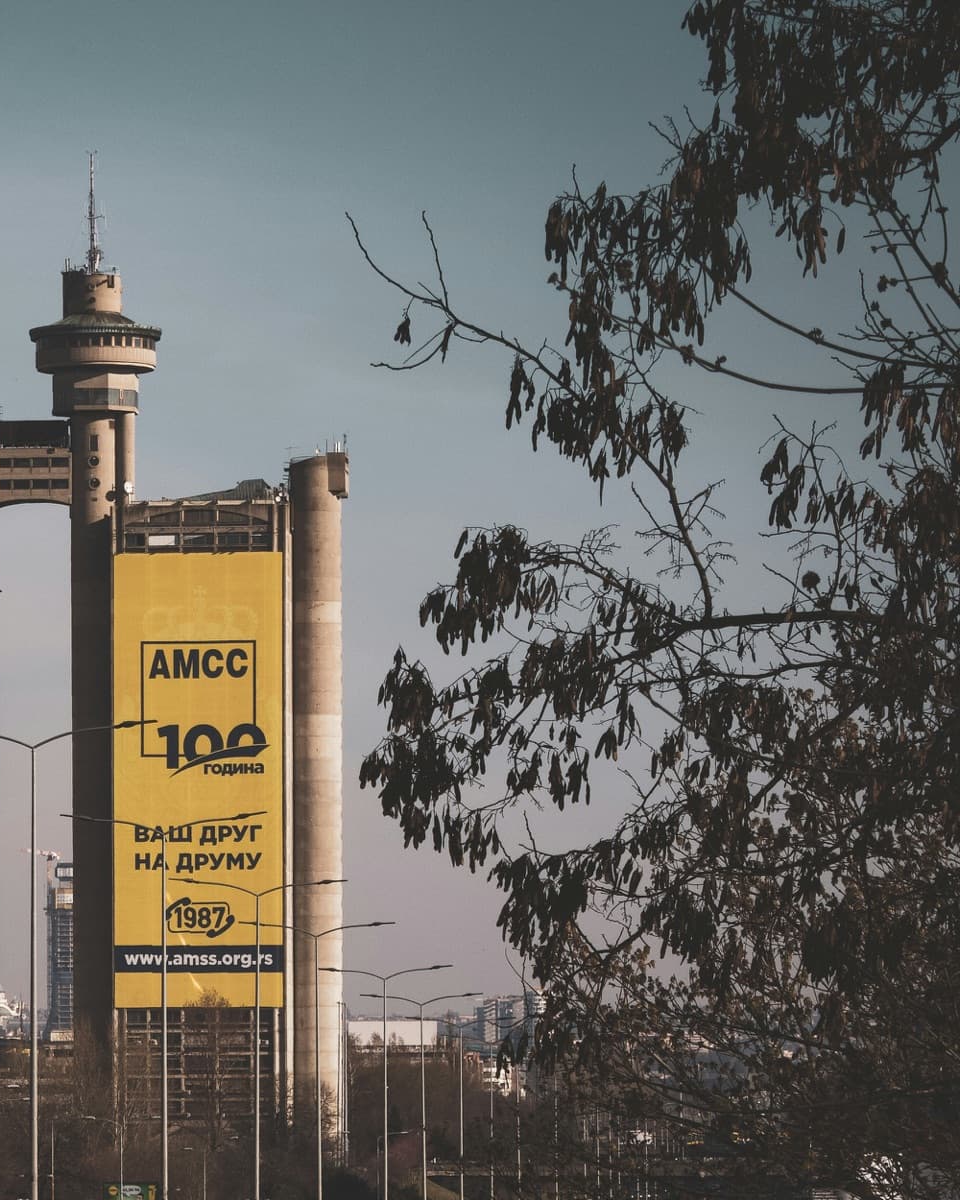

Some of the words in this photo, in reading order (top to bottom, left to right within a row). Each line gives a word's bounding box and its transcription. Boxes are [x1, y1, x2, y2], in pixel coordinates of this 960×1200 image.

[156, 723, 267, 770] 100
[203, 762, 265, 777] година
[134, 824, 193, 843] ВАШ
[199, 824, 263, 846] ДРУГ
[134, 853, 170, 871] НА
[176, 852, 263, 874] ДРУМУ
[173, 906, 226, 929] 1987
